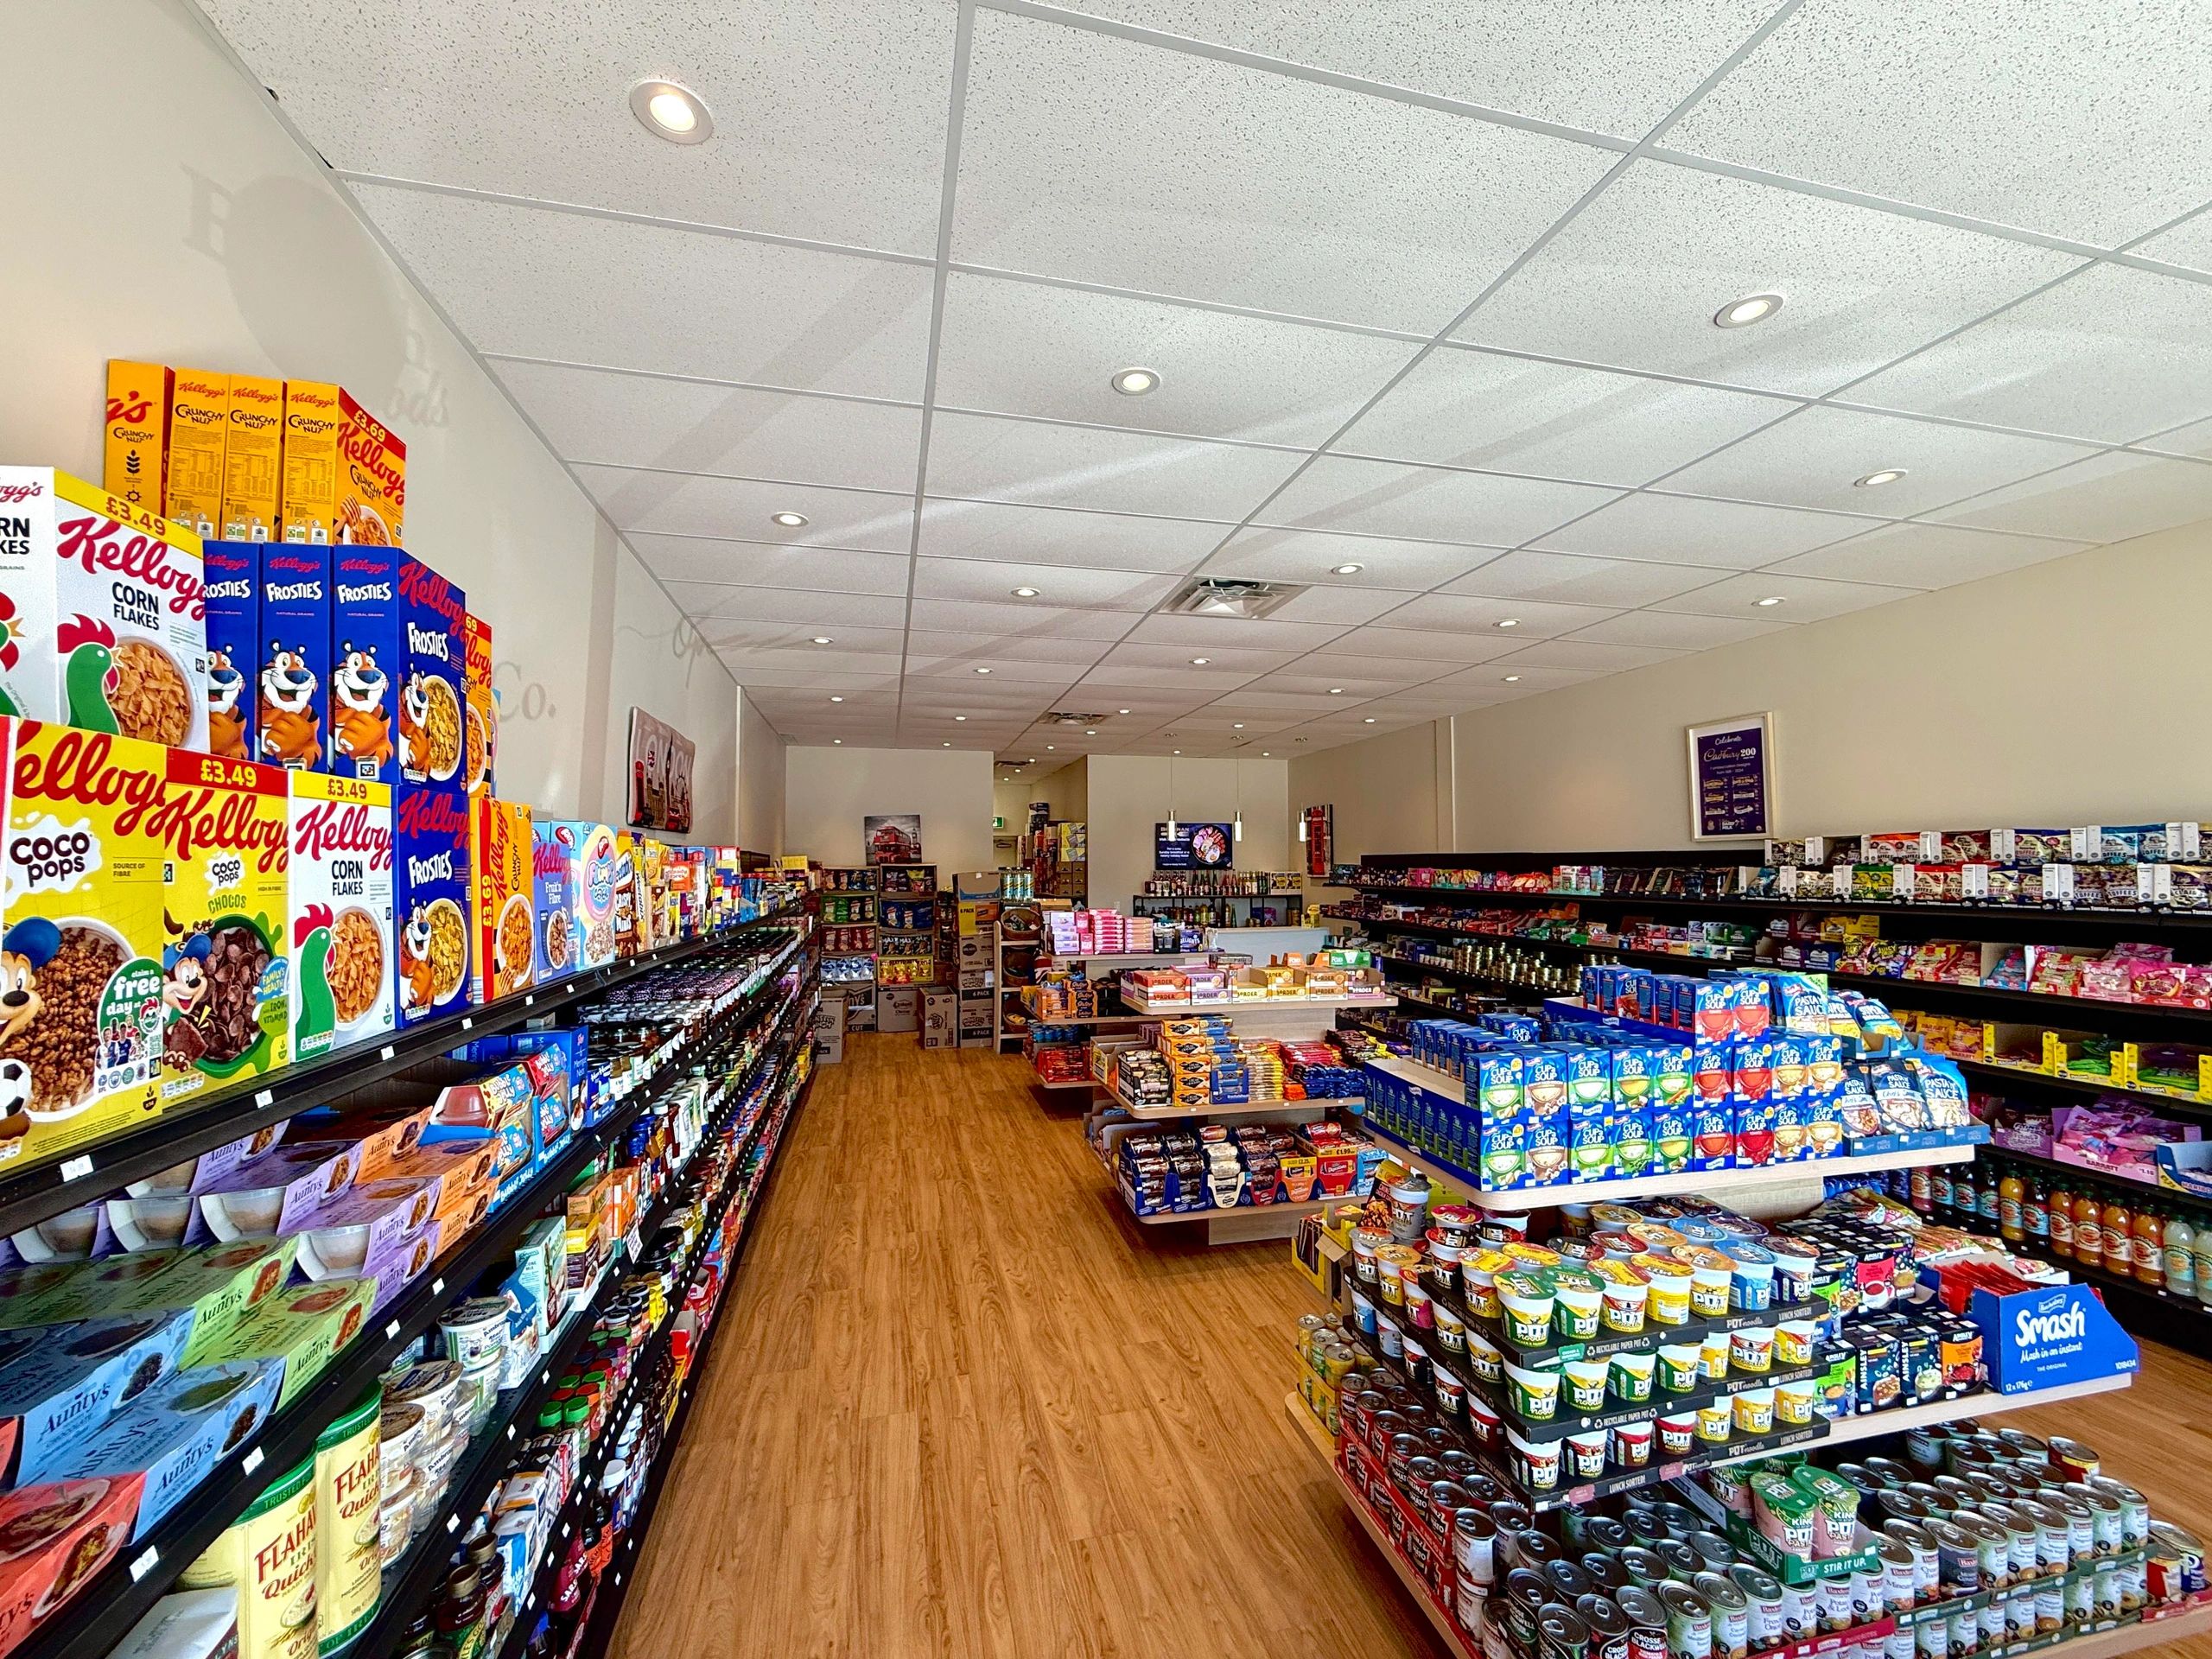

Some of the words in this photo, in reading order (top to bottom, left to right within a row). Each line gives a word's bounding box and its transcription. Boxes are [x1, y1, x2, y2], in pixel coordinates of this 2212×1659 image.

[178, 381, 226, 398] Kellogg's
[232, 387, 279, 404] Kellogg's
[290, 392, 335, 409] Kellogg's
[175, 404, 226, 421] CRUNCHY
[191, 416, 213, 425] NUT
[230, 409, 278, 427] CRUNCHY
[245, 421, 266, 429] NUT
[288, 414, 335, 430] CRUNCHY
[354, 410, 386, 442] £3.69
[349, 464, 382, 499] CRUNCHY
[105, 496, 166, 537] £3.49
[204, 578, 251, 600] ROSTIES
[265, 581, 323, 603] FROSTIES
[337, 582, 392, 604] FROSTIES
[112, 582, 159, 614] CORN
[114, 603, 160, 631] FLAKES
[407, 621, 449, 662] FROSTIES
[1714, 735, 1743, 746] Celebrate
[1703, 747, 1741, 762] Cadbury
[1740, 747, 1757, 757] 200
[200, 759, 257, 788] £3.49
[327, 778, 368, 799] £3.49
[28, 855, 86, 887] pops
[331, 860, 363, 880] CORN
[408, 850, 452, 888] FROSTIES
[332, 881, 364, 896] FLAKES
[207, 893, 247, 913] CHOCOS
[482, 874, 493, 926] £3.69
[113, 976, 161, 1001] free
[106, 1001, 131, 1017] day
[1740, 997, 1761, 1006] SOUP
[1795, 995, 1819, 1007] PASTA
[1744, 1058, 1764, 1068] SOUP
[1815, 1052, 1834, 1062] SOUP
[1578, 1067, 1600, 1077] SOUP
[1662, 1063, 1684, 1072] SOUP
[1535, 1071, 1557, 1082] SOUP
[1925, 1078, 1949, 1090] PASTA
[1845, 1086, 1866, 1095] SAUCE
[1889, 1080, 1910, 1090] SAUCE
[1926, 1089, 1958, 1100] SAUCE
[1778, 1116, 1798, 1126] SOUP
[1813, 1112, 1834, 1122] SOUP
[1623, 1129, 1643, 1139] SOUP
[1491, 1140, 1514, 1150] SOUP
[1692, 1293, 1729, 1308] POT
[1609, 1309, 1643, 1323] POT
[1778, 1309, 1793, 1320] LUNCH
[1794, 1306, 1812, 1318] SORTED!
[1515, 1322, 1549, 1337] POT
[1726, 1318, 1744, 1329] POT
[1743, 1316, 1764, 1327] noodle
[2015, 1300, 2086, 1347] Smash
[1437, 1327, 1465, 1344] POT
[1596, 1342, 1619, 1354] RECYCLABLE
[1620, 1340, 1632, 1351] PAPER
[1632, 1338, 1642, 1349] POT
[2020, 1348, 2040, 1363] Mash
[2040, 1348, 2050, 1358] in
[2050, 1349, 2058, 1357] an
[2058, 1341, 2082, 1355] instant
[1732, 1348, 1768, 1364] POT
[1901, 1341, 1910, 1382] AINSLEY
[1471, 1354, 1502, 1375] POT
[1859, 1349, 1868, 1390] AINSLEY
[2046, 1362, 2068, 1370] ORIGINAL
[2115, 1359, 2137, 1370] 1018434
[1779, 1373, 1794, 1383] LUNCH
[1795, 1369, 1813, 1381] SORTED!
[1726, 1382, 1744, 1393] POT
[1743, 1379, 1764, 1390] noodle
[1603, 1414, 1627, 1426] RECYCLABLE
[1628, 1412, 1639, 1423] PAPER
[1639, 1410, 1649, 1421] POT
[1780, 1433, 1795, 1445] LUNCH
[1795, 1430, 1813, 1442] SORTED!
[1728, 1445, 1745, 1456] POT
[1745, 1442, 1765, 1453] noodle
[1609, 1482, 1625, 1493] LUNCH
[1625, 1475, 1645, 1491] SORTED!
[1765, 1483, 1791, 1497] POT
[264, 1483, 301, 1510] TRUSTED
[1823, 1561, 1843, 1573] STIR
[1843, 1560, 1853, 1570] IT
[1853, 1557, 1866, 1568] UP.
[1633, 1631, 1662, 1644] CROSSE
